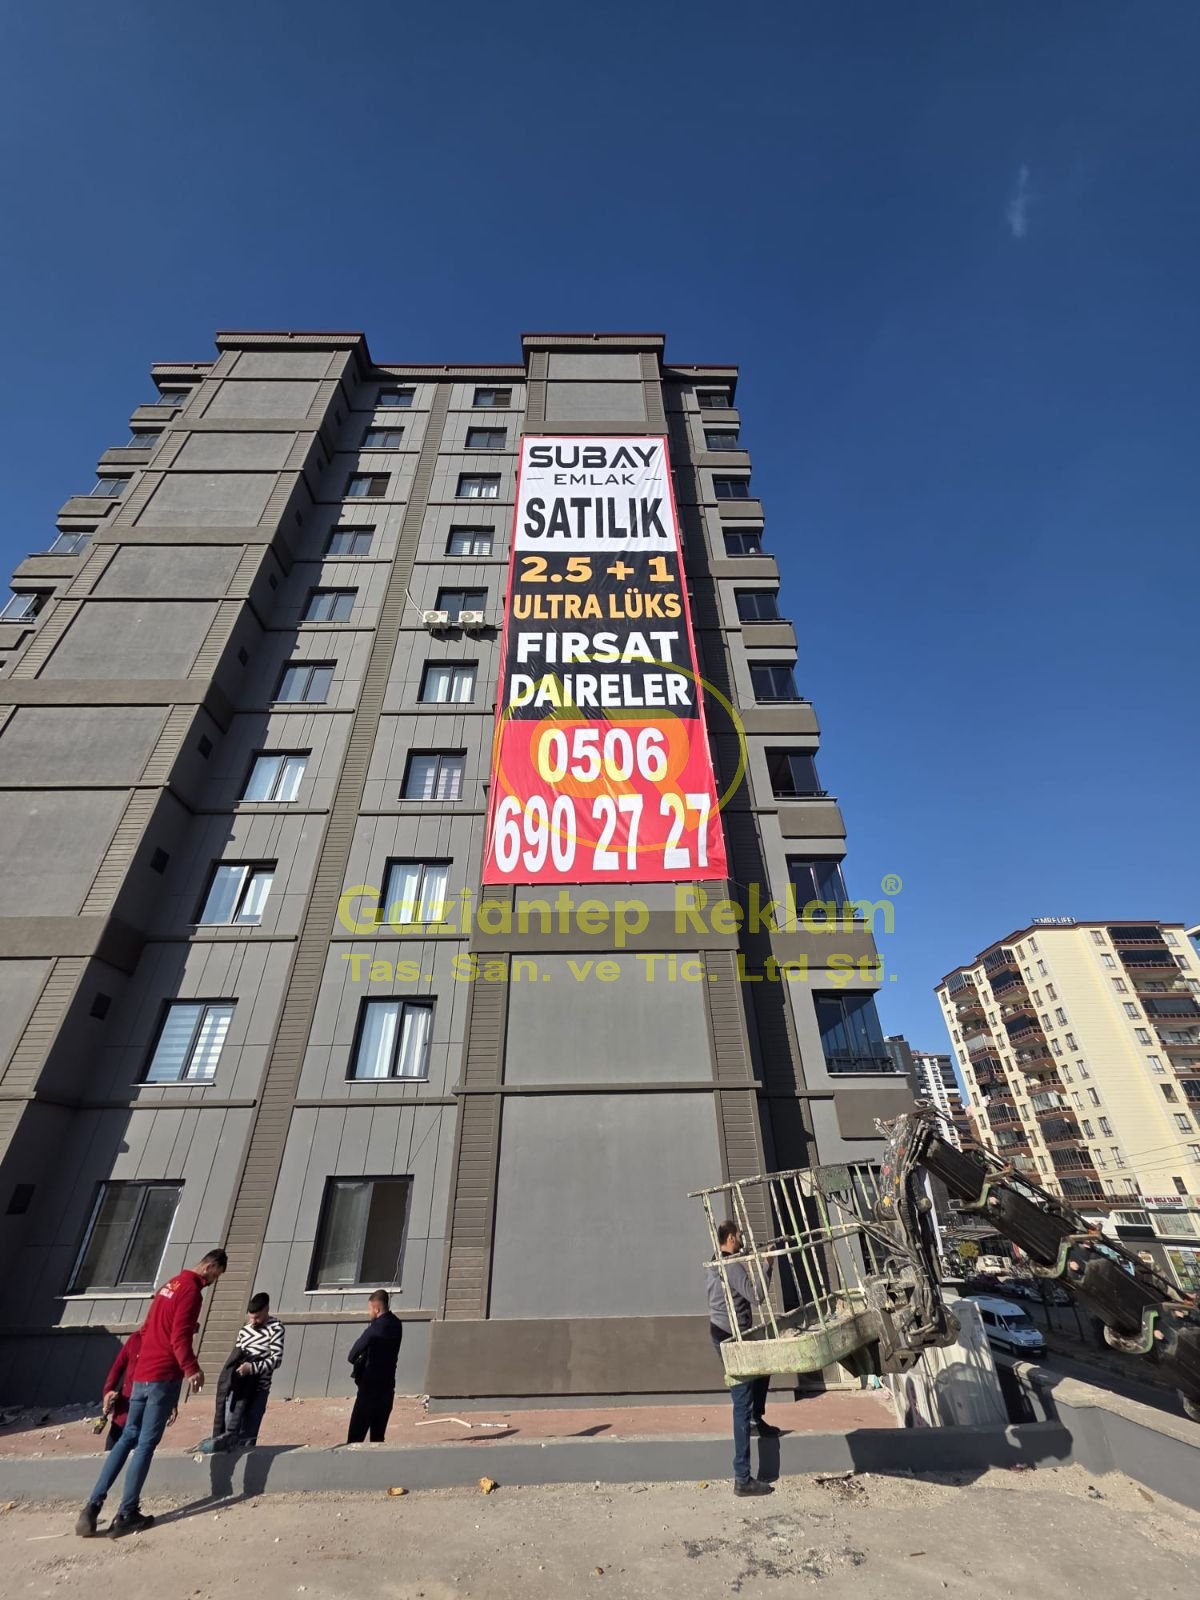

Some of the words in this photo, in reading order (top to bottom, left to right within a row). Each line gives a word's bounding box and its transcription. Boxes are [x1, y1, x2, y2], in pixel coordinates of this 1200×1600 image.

[528, 446, 658, 469] SUBAY
[553, 473, 637, 486] EMLAK
[523, 497, 668, 539] SATILIK
[520, 556, 593, 583] 2.5
[606, 560, 635, 581] +
[648, 556, 675, 583] 1
[513, 594, 604, 620] ULTRA
[608, 587, 682, 619] LÜKS
[516, 631, 679, 664] FIRSAT
[537, 727, 669, 783] 0506
[494, 794, 577, 873] 690
[591, 793, 644, 871] 27
[659, 792, 711, 870] 27
